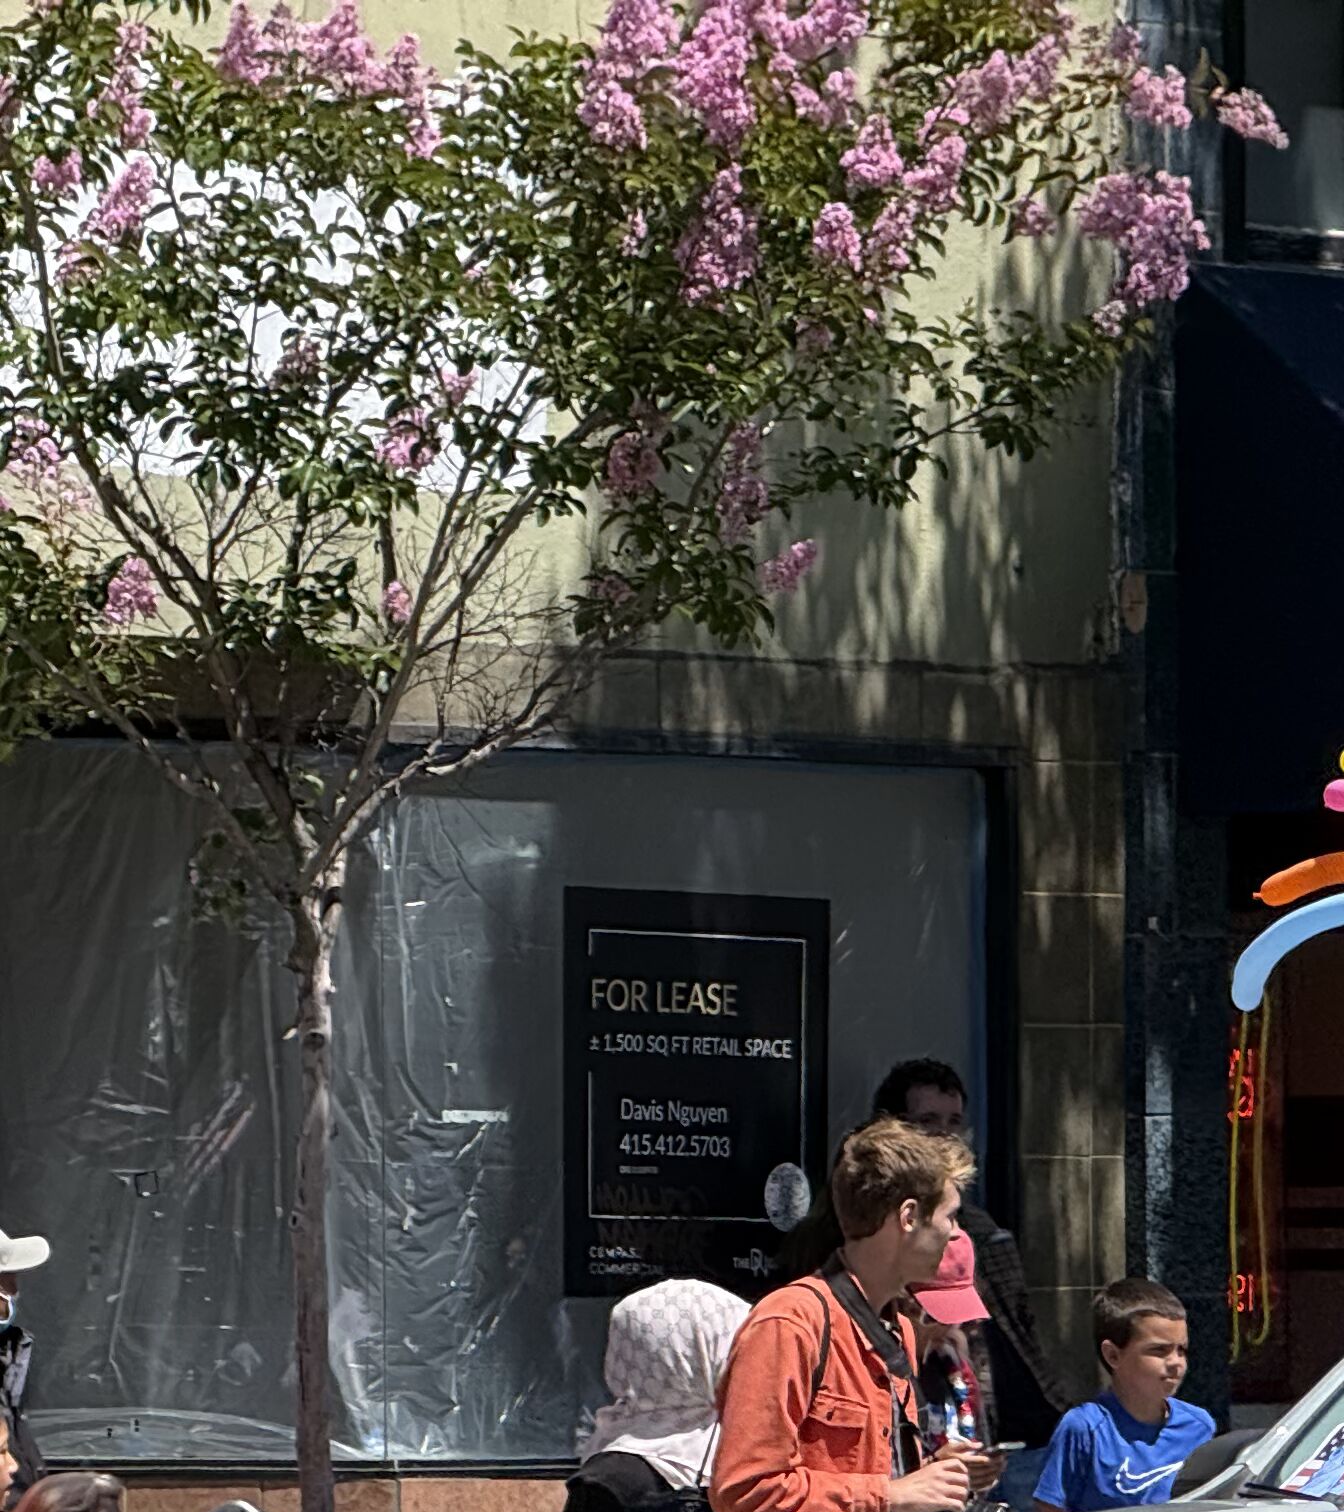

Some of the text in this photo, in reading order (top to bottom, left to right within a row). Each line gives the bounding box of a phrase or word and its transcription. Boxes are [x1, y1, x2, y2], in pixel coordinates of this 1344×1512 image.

[590, 977, 739, 1018] FOR LEASE
[646, 1034, 668, 1057] SQ
[671, 1036, 690, 1055] FT
[692, 1036, 742, 1057] RETAIL
[744, 1038, 794, 1060] SPACE
[620, 1097, 729, 1128] Davis Nguyen
[619, 1133, 731, 1158] 415.412.5703
